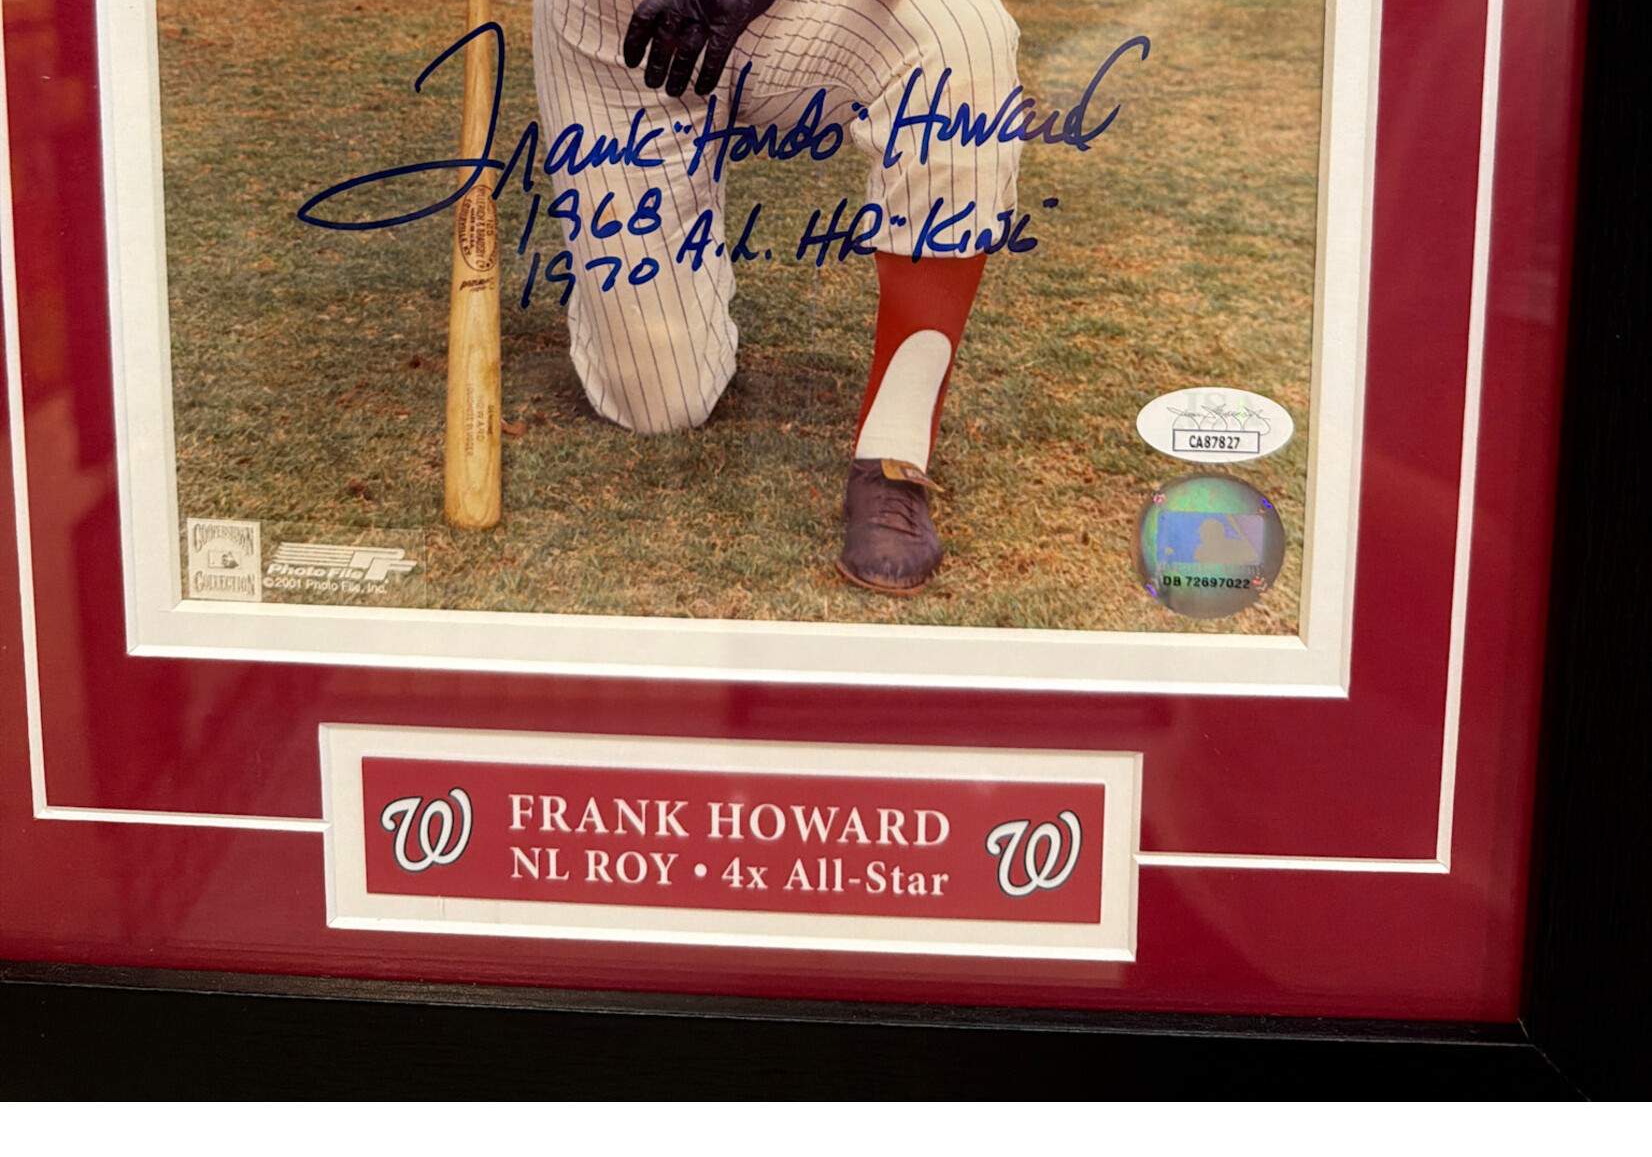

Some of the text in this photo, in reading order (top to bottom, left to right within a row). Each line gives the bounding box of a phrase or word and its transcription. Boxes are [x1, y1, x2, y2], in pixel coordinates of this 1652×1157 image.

[297, 22, 666, 230] Frank
[883, 35, 1151, 169] Howard
[518, 187, 662, 255] 1968
[676, 203, 772, 272] A.L.
[797, 198, 883, 267] HR
[519, 251, 660, 309] 1970
[1189, 435, 1240, 449] CA87827
[266, 563, 364, 579] Photo File
[305, 579, 339, 591] Photo
[1163, 575, 1250, 589] DB 72697022
[379, 787, 474, 873] W
[507, 793, 951, 847] FRANK HOWARD
[510, 846, 950, 898] NL ROY 4x All-Star
[984, 809, 1083, 898] W
